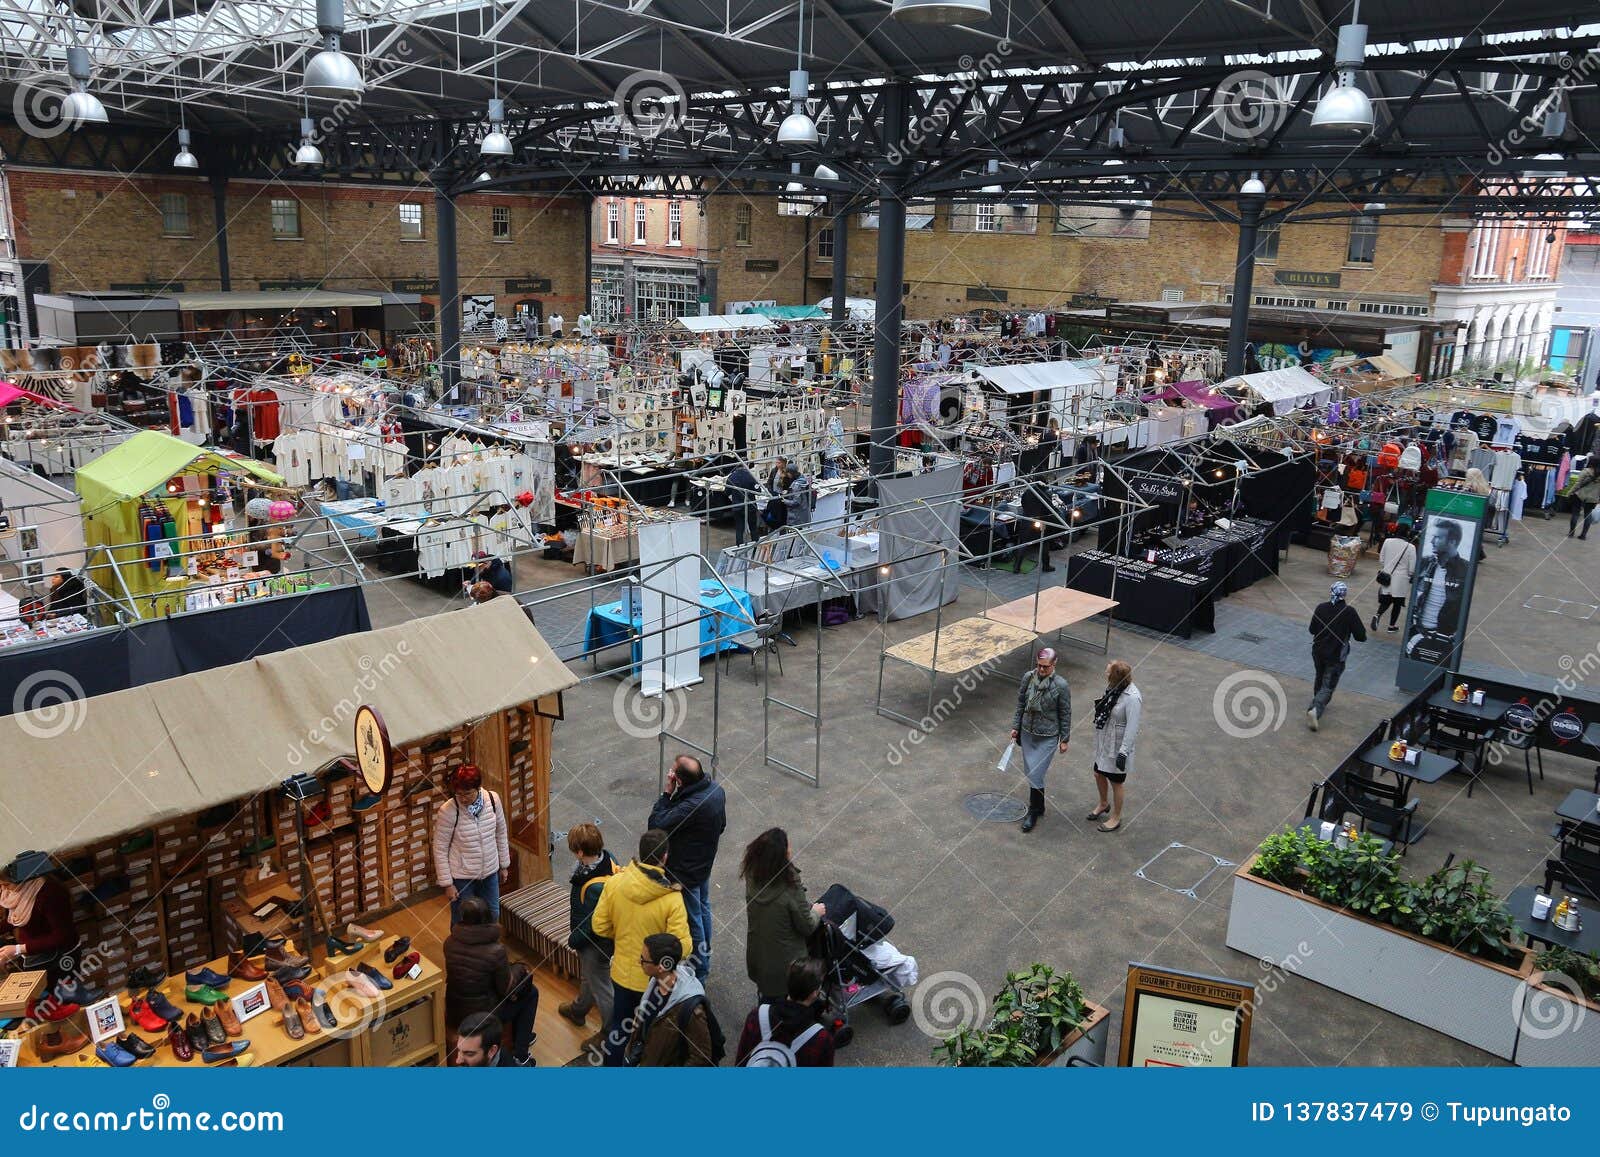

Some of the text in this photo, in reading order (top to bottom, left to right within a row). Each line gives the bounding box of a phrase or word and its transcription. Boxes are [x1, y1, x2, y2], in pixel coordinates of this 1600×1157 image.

[1140, 975, 1242, 1000] GOURMET BURGER KITCHEN
[1174, 1011, 1198, 1020] GOURMET
[1174, 1017, 1198, 1026] BURGER
[1173, 1023, 1197, 1032] KITCHEN
